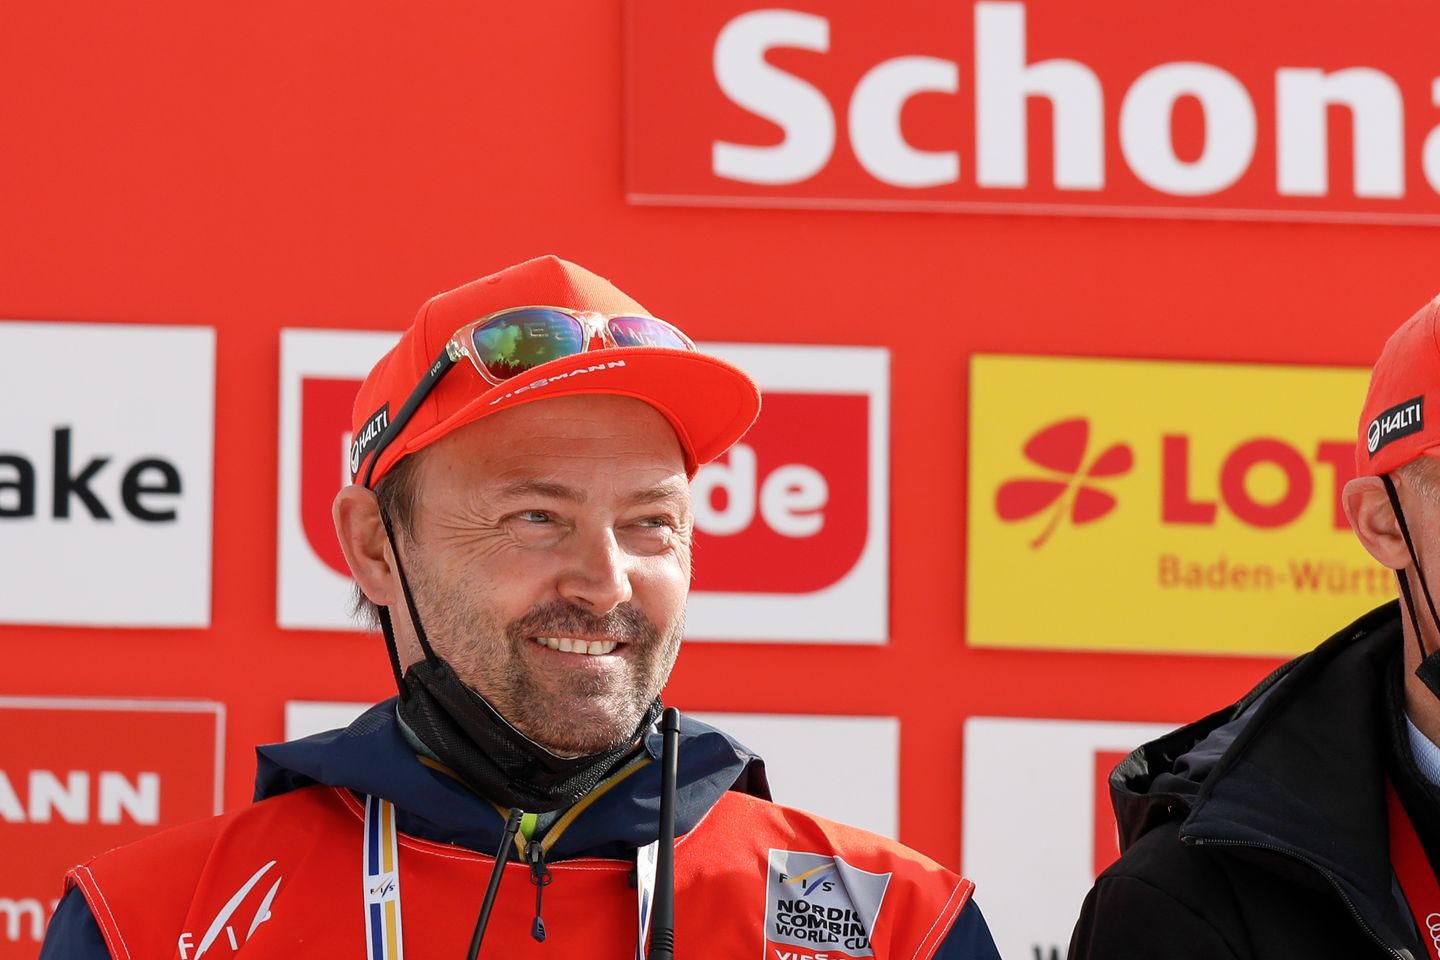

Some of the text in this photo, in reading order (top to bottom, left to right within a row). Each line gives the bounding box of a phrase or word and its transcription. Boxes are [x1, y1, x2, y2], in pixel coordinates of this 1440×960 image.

[359, 410, 388, 452] HALTI
[1381, 404, 1421, 437] HALTI
[0, 426, 183, 523] ake
[776, 923, 840, 943] WORLD
